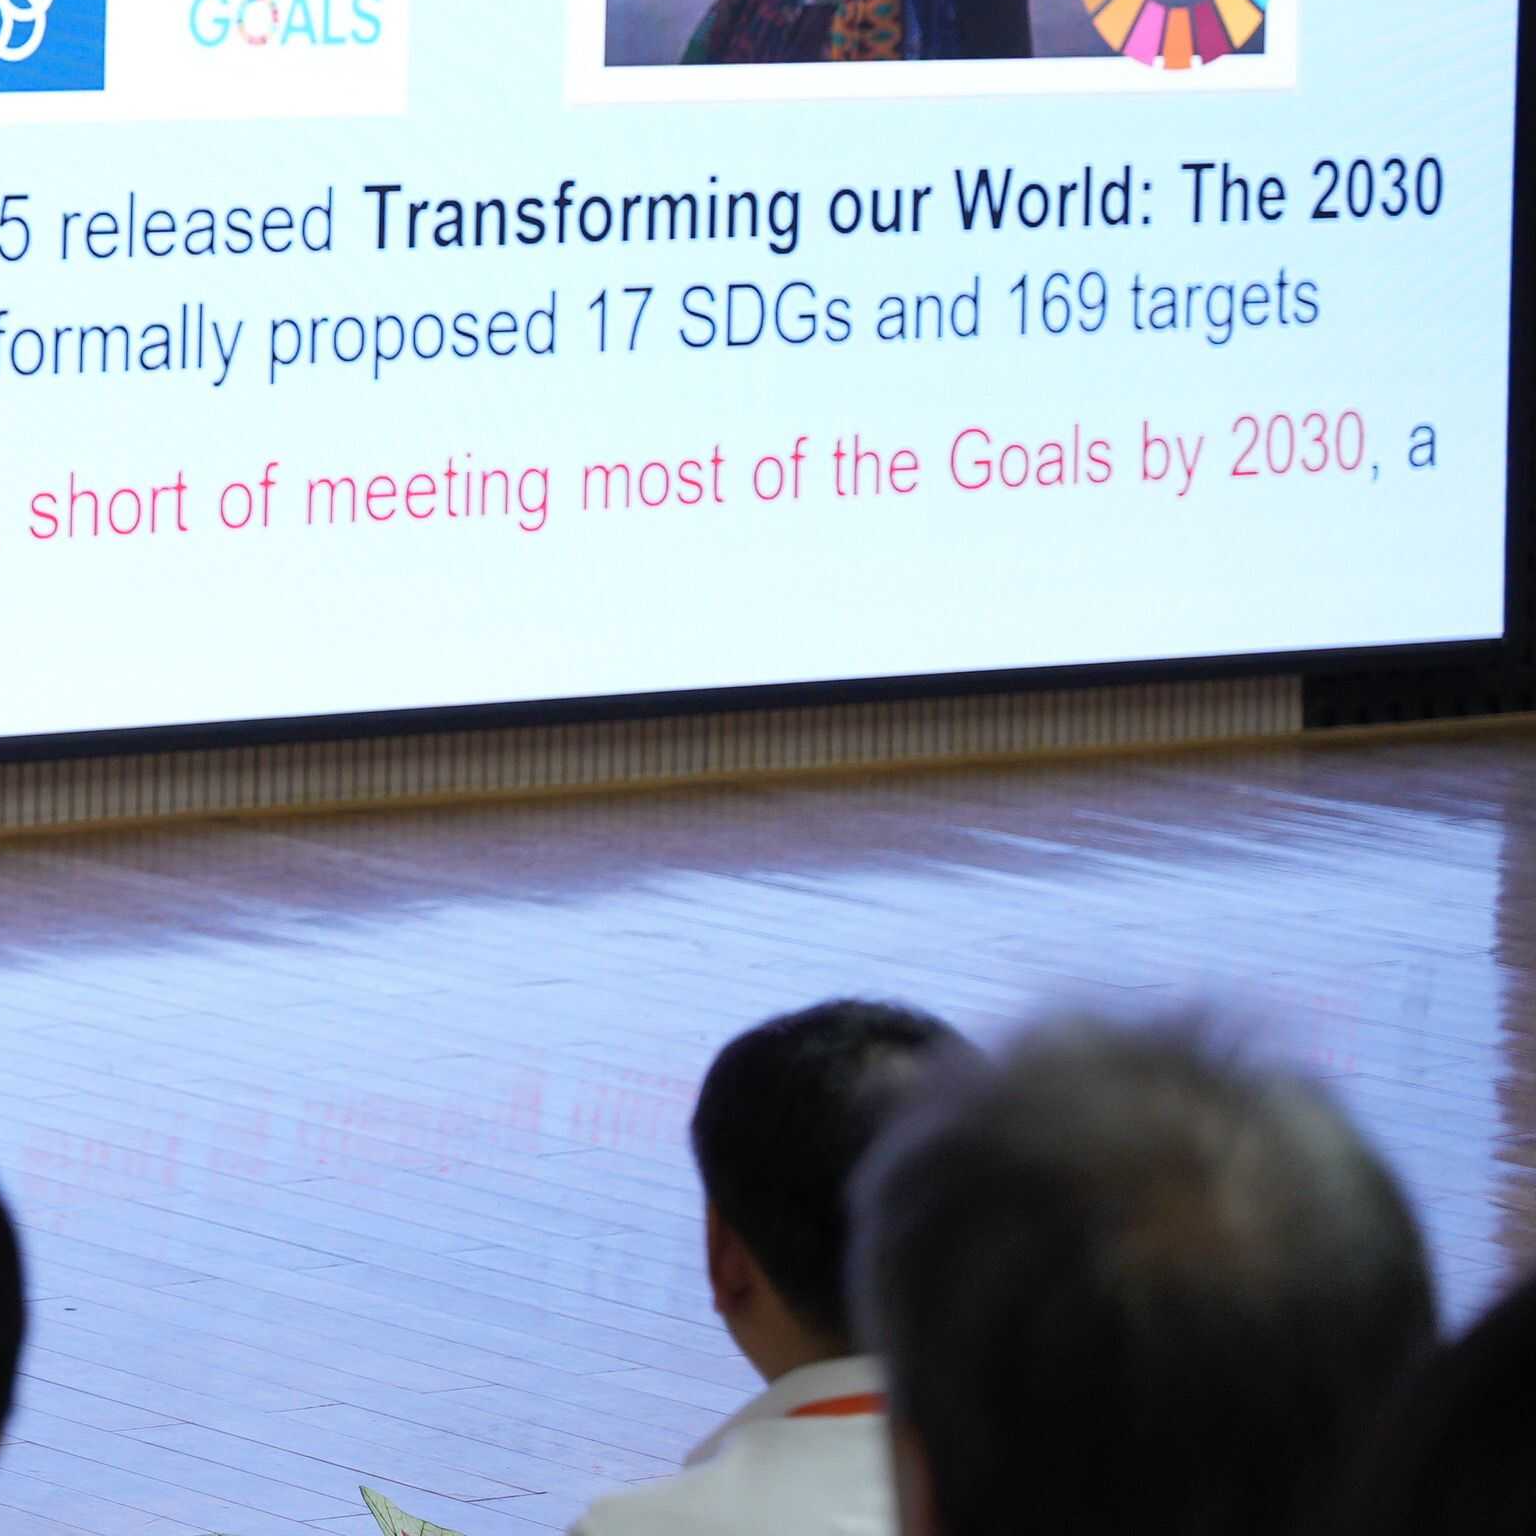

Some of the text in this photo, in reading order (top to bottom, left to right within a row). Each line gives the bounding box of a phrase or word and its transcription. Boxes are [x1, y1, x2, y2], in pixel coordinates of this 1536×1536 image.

[62, 186, 332, 259] released
[364, 176, 799, 254] Transforming
[829, 187, 932, 234] our
[955, 165, 1150, 230] World:
[1181, 162, 1286, 223] The
[1311, 157, 1443, 219] 2030
[271, 291, 555, 384] proposed
[590, 287, 653, 352] 17
[680, 282, 851, 348] SDGs
[877, 276, 979, 340] and
[1011, 272, 1106, 334] 169
[1131, 270, 1318, 344] targets
[30, 472, 188, 539] short
[221, 462, 278, 528] of
[308, 453, 548, 531] meeting
[584, 445, 724, 510] most
[754, 437, 808, 500] of
[833, 435, 918, 496] the
[950, 424, 1111, 489] Goals
[1143, 421, 1203, 496] by
[1231, 411, 1378, 480] 2030,
[1408, 424, 1436, 467] a
